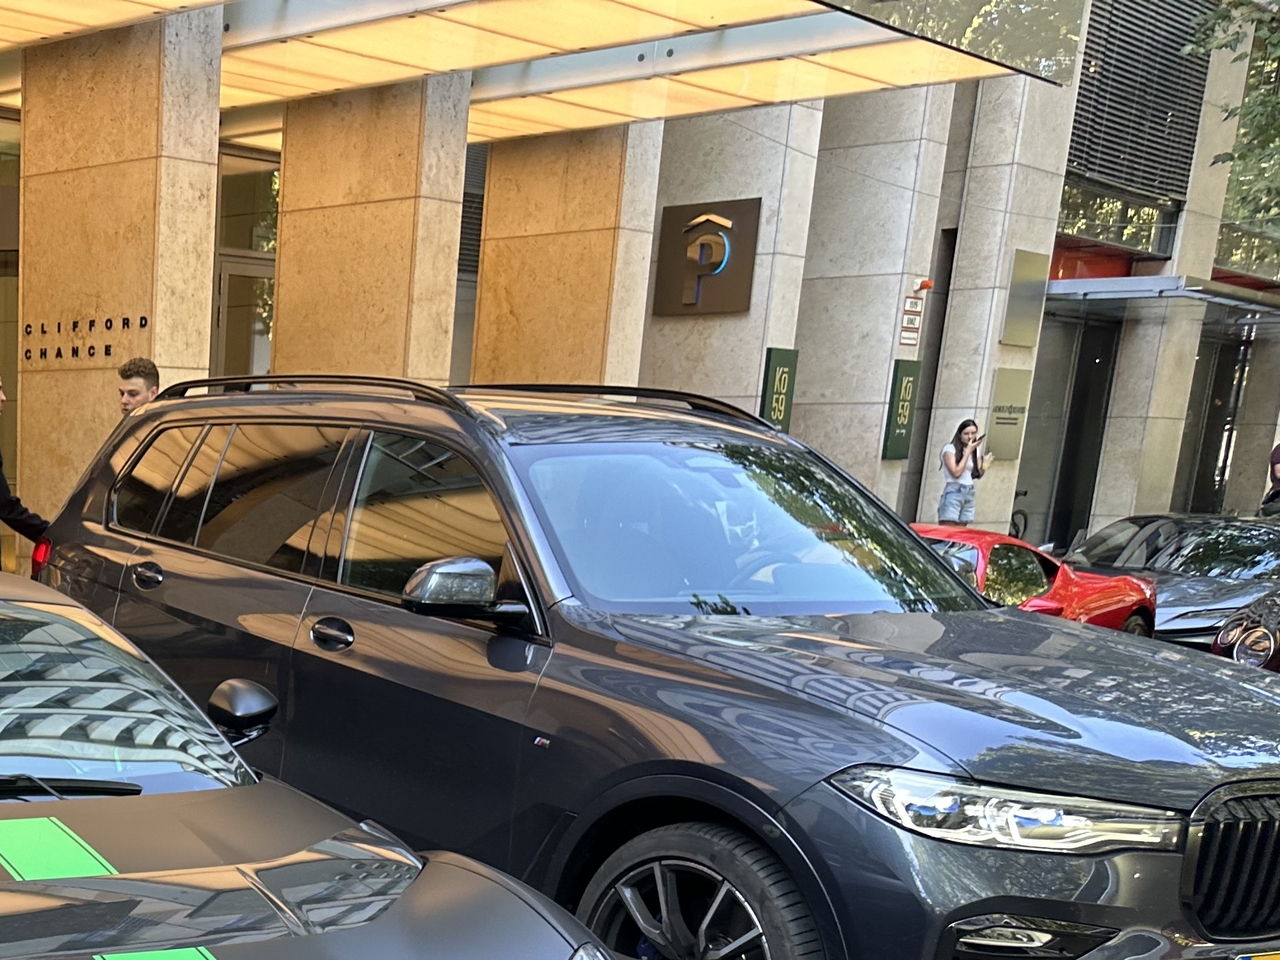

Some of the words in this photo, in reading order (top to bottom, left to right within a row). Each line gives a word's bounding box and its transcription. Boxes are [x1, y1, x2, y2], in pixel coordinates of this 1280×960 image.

[682, 231, 732, 306] P
[24, 316, 148, 336] CLIFFORD
[24, 344, 112, 360] CHANCE
[770, 394, 786, 421] 59
[896, 401, 911, 425] 59
